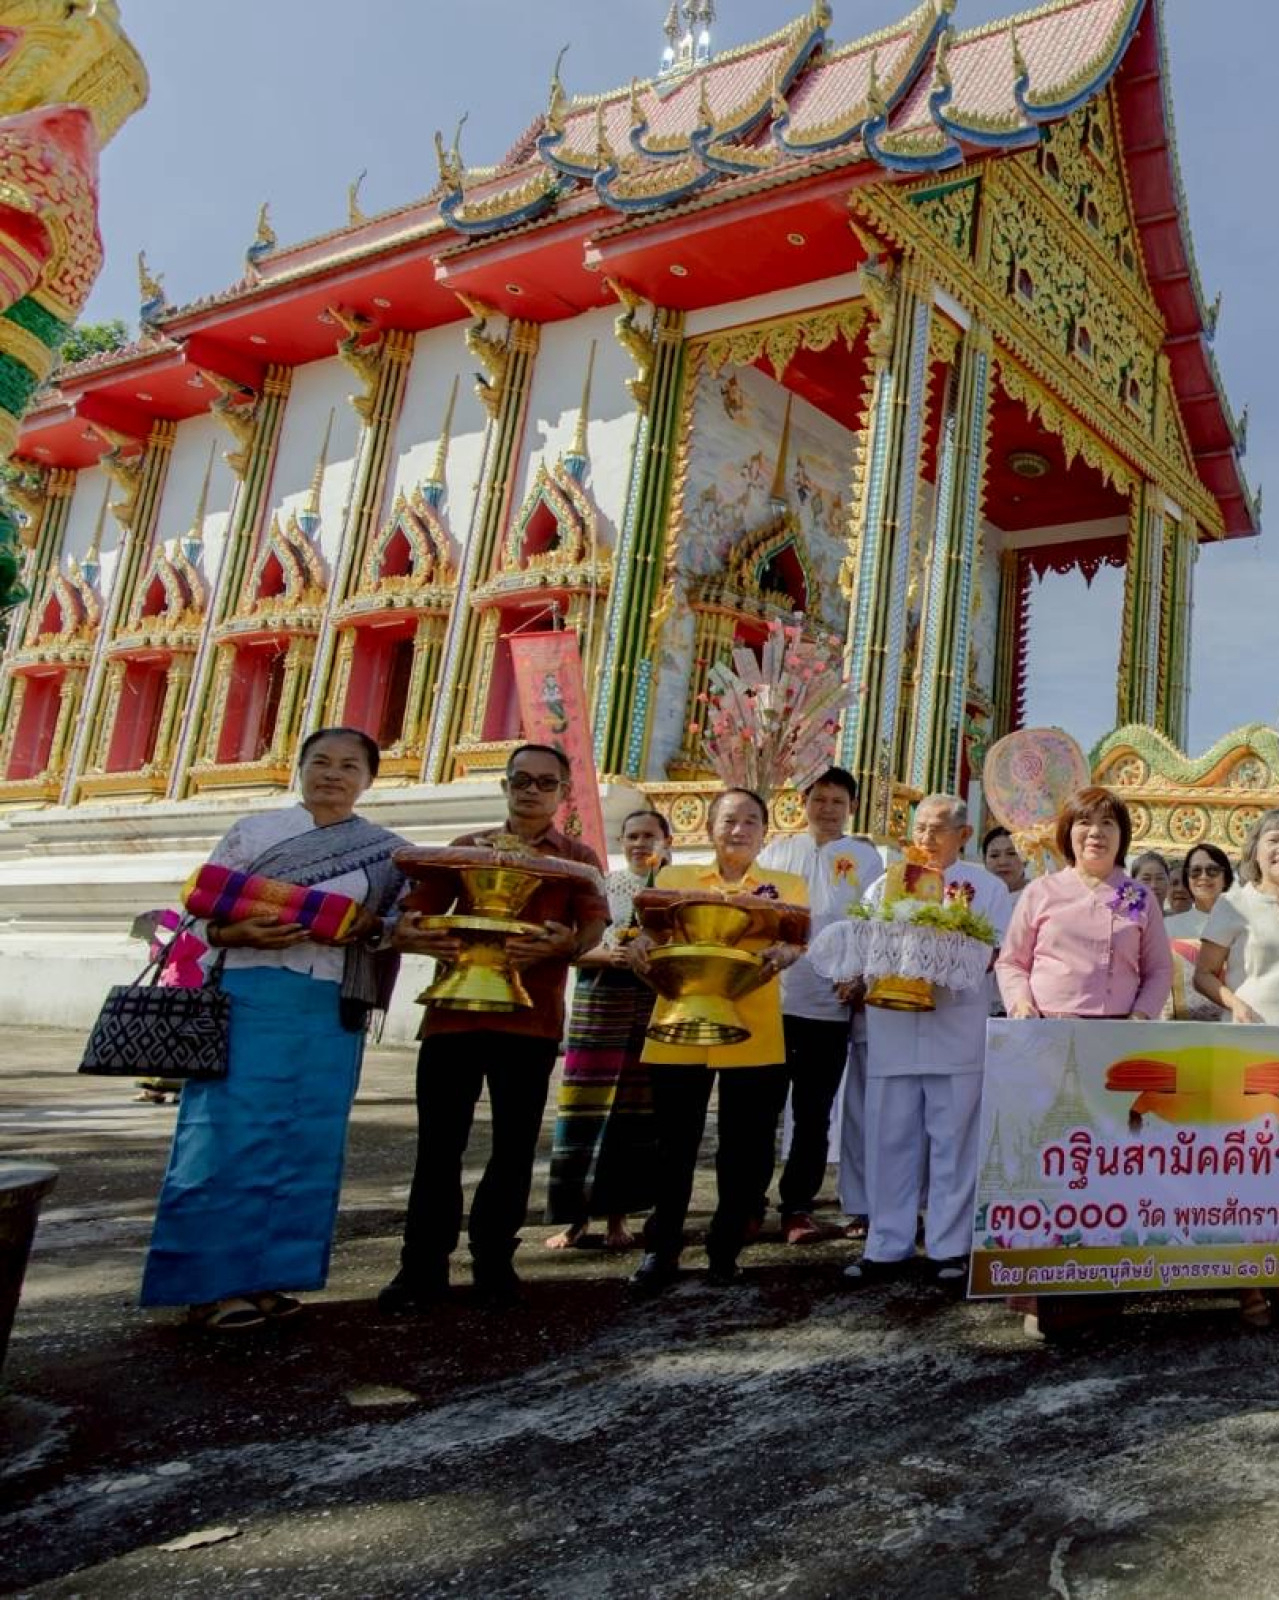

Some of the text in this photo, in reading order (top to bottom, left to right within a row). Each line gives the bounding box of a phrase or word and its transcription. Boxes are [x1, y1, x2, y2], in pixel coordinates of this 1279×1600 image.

[990, 1203, 1128, 1235] ๓๐,๐๐๐
[1137, 1198, 1166, 1228] วัด
[991, 1262, 1022, 1283] โดย
[1264, 1254, 1276, 1276] ปี
